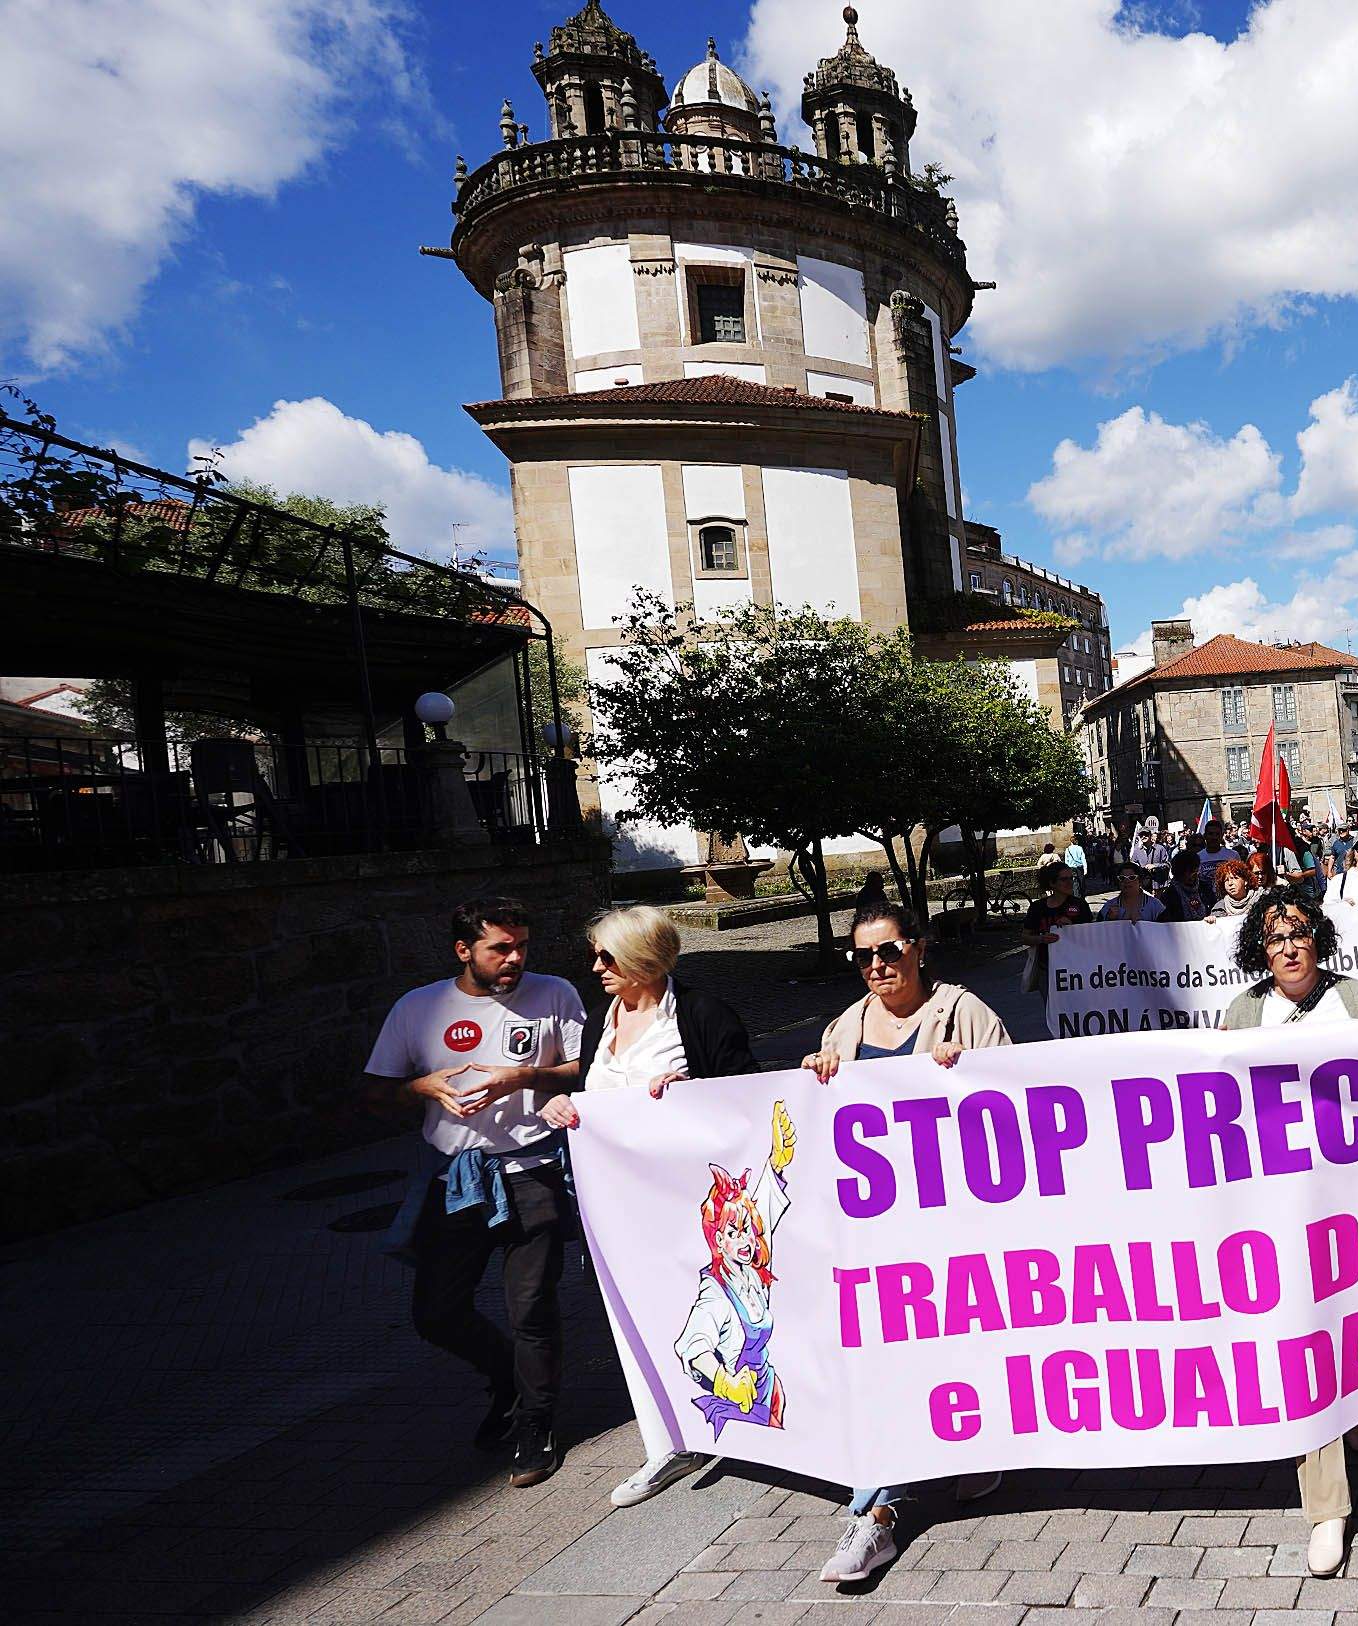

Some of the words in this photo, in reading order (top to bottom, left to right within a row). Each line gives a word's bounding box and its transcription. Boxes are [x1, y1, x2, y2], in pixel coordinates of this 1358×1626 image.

[1056, 968, 1083, 991] En
[1089, 964, 1171, 991] defensa
[1177, 965, 1202, 989] da
[1059, 1009, 1130, 1039] NON
[834, 1086, 1087, 1218] STOP
[833, 1231, 1280, 1347] TRABALLO
[929, 1381, 981, 1441] e
